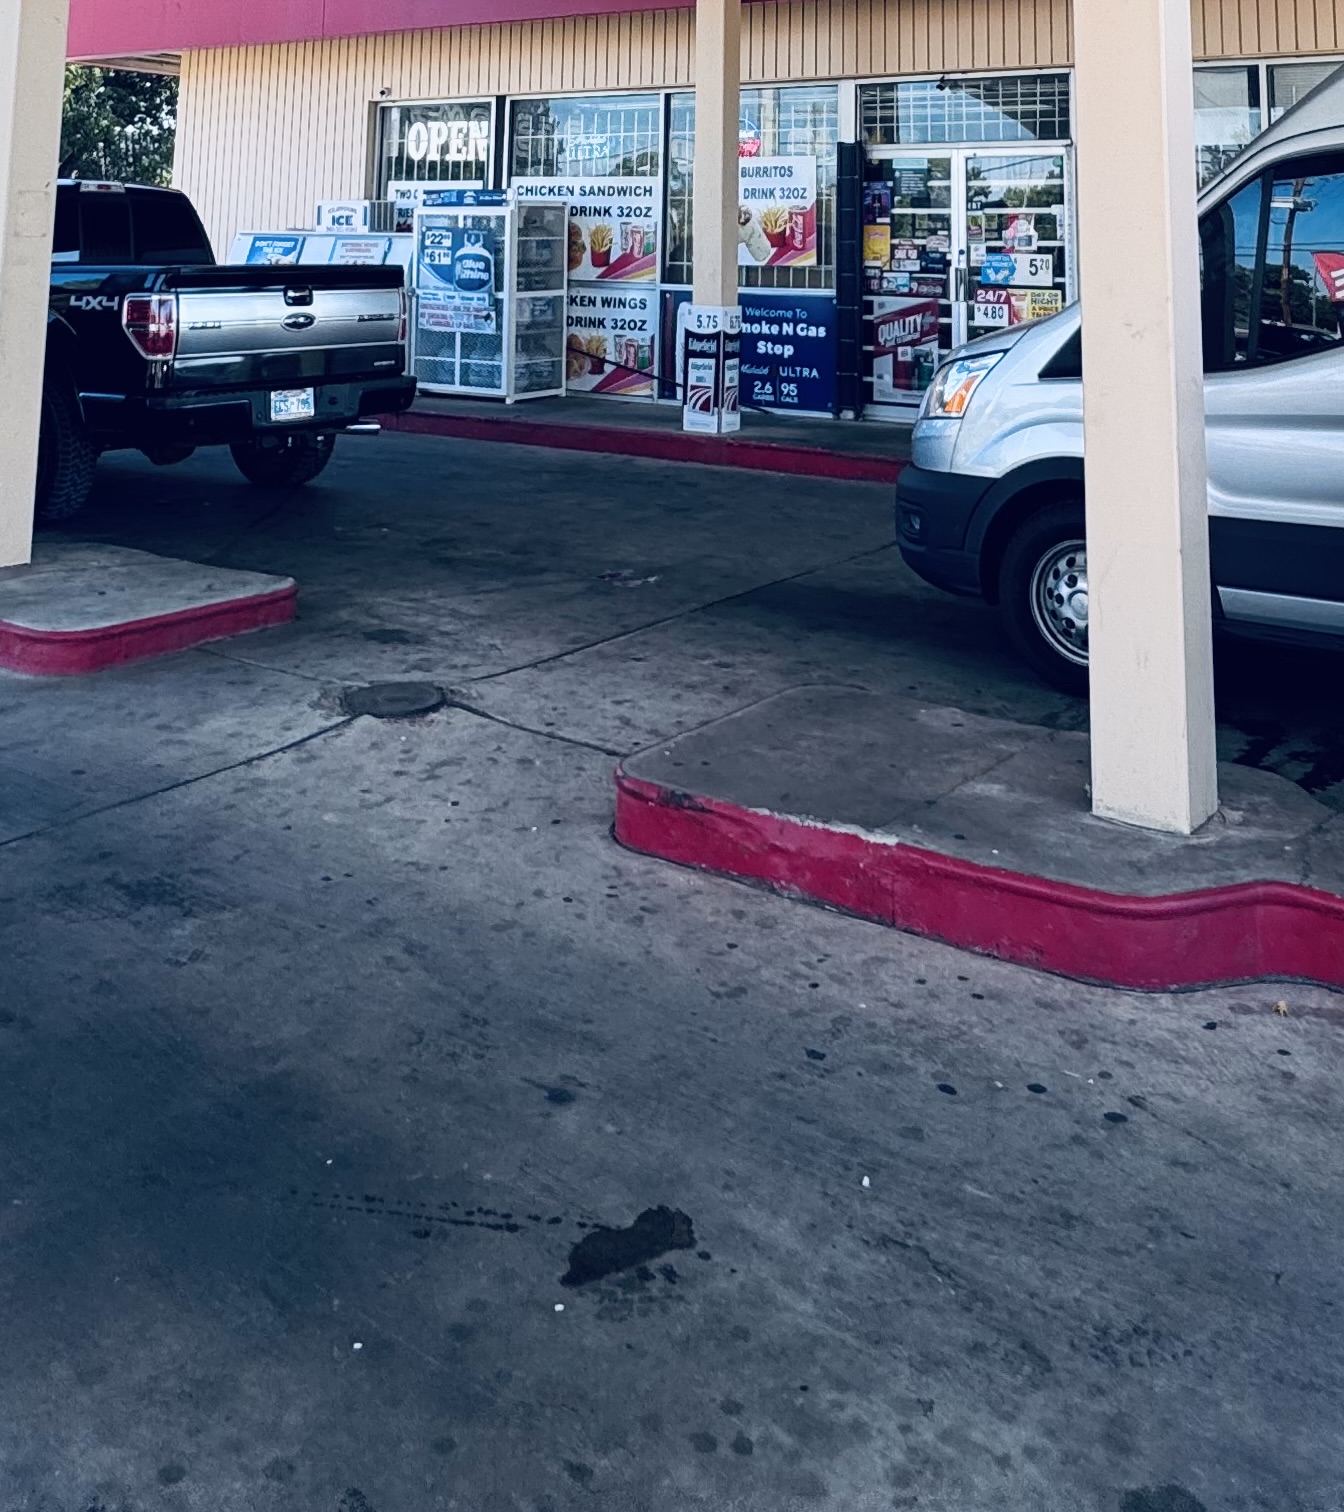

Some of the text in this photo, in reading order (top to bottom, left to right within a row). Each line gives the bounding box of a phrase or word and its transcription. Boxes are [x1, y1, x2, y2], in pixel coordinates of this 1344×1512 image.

[407, 121, 488, 161] OPEN
[741, 166, 794, 178] BURRITOS
[517, 185, 653, 197] CHICKEN SANDWICH
[743, 187, 776, 199] DRINK
[570, 206, 613, 217] DRINK
[331, 215, 353, 226] ICE
[69, 295, 118, 310] 4X4
[601, 296, 648, 310] WINGS
[976, 289, 1007, 303] 24/7
[745, 307, 807, 319] Welcome To
[567, 315, 607, 329] DRINK
[696, 314, 718, 328] 5.75
[740, 321, 827, 337] moke N Gas
[878, 313, 922, 346] QUALITY
[756, 340, 795, 358] Stop
[779, 367, 819, 378] ULTRA
[753, 381, 798, 395] 2.6 95
